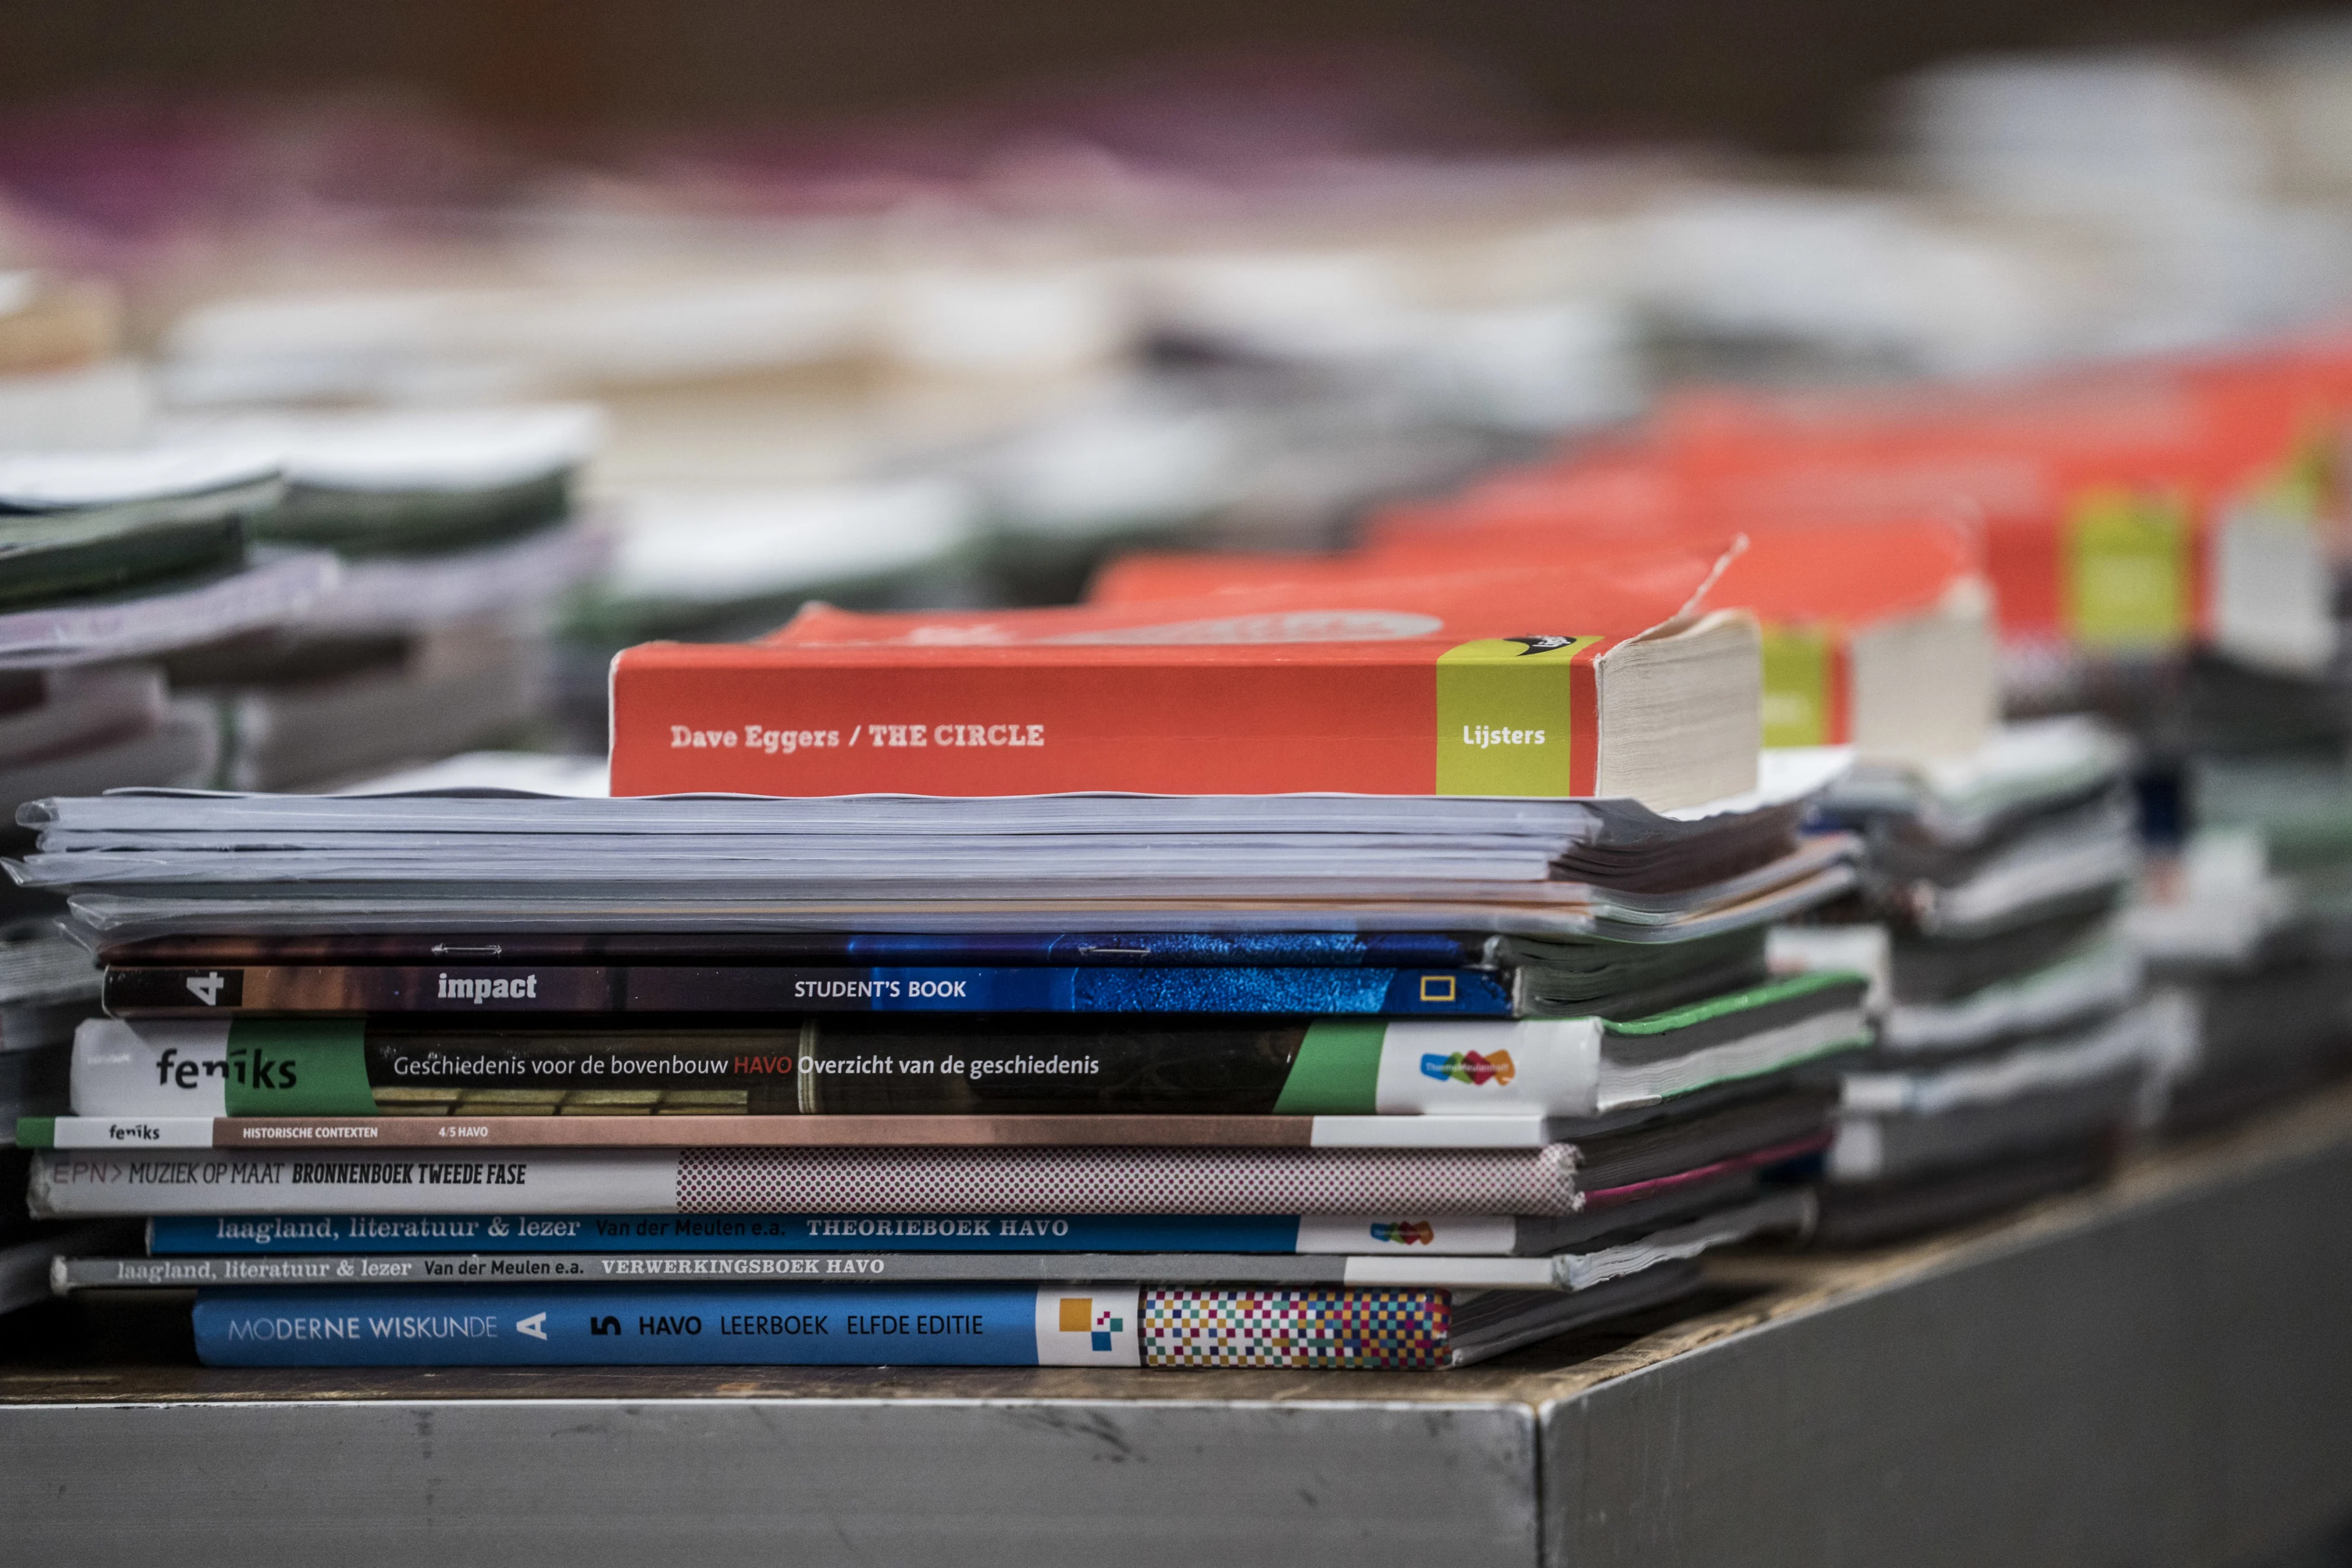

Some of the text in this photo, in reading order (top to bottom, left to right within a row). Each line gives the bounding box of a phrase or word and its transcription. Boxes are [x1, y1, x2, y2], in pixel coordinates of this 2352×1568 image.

[671, 725, 737, 747] Dave
[744, 725, 839, 753] Eggers
[869, 725, 927, 746] THE
[934, 725, 1044, 746] CIRCLE
[1463, 725, 1545, 748] Lijsters
[186, 971, 224, 1006] 4
[438, 973, 537, 1004] impact
[908, 981, 967, 998] BOOK
[394, 1055, 1099, 1079] Geschiedenis voor de bovenbouw HAVO Overzicht van de geschiedenis
[243, 1127, 378, 1139] HISTORISCHE CONTEXTEN
[439, 1126, 488, 1137] 4/5 HAVO
[129, 1163, 198, 1184] MUZIEK
[203, 1163, 227, 1184] OP
[231, 1163, 285, 1184] MAAT
[292, 1163, 413, 1185] BRONNENBOEK
[418, 1163, 483, 1185] TWEEDE
[487, 1164, 527, 1185] FASE
[217, 1217, 1069, 1244] laagland, literatuur & lezer Van der Meulen e.a. THEORIEBOEK HAVO
[117, 1259, 884, 1284] laagland, literatuur & lezer Van der Meulen e.a. VERWERKINGSBOEK HAVO
[228, 1312, 983, 1340] MODERNE WISKUNDE A 5 HAVO LEERBOEK ELFDE EDITIE
